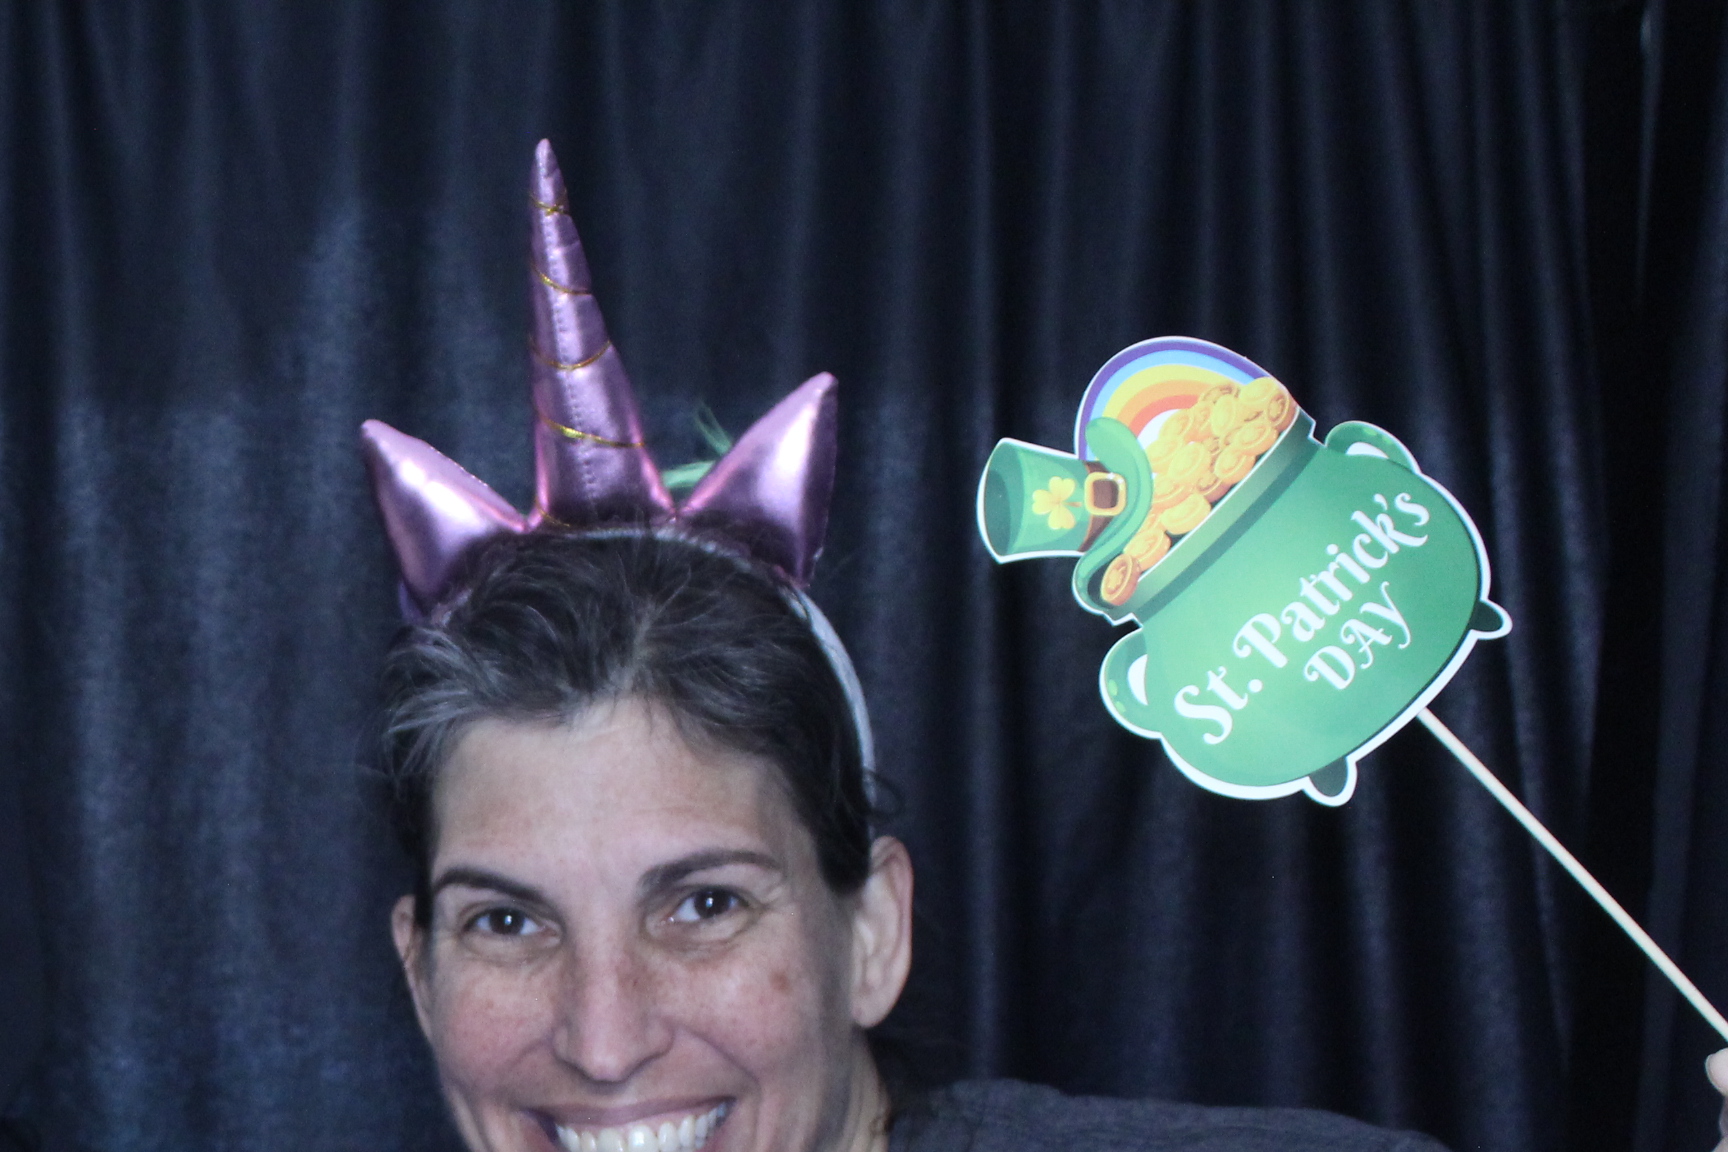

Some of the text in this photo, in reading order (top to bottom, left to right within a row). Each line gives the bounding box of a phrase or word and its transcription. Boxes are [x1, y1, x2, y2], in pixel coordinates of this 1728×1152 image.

[1173, 492, 1431, 745] St. Patrick's
[1302, 581, 1412, 690] DAY
